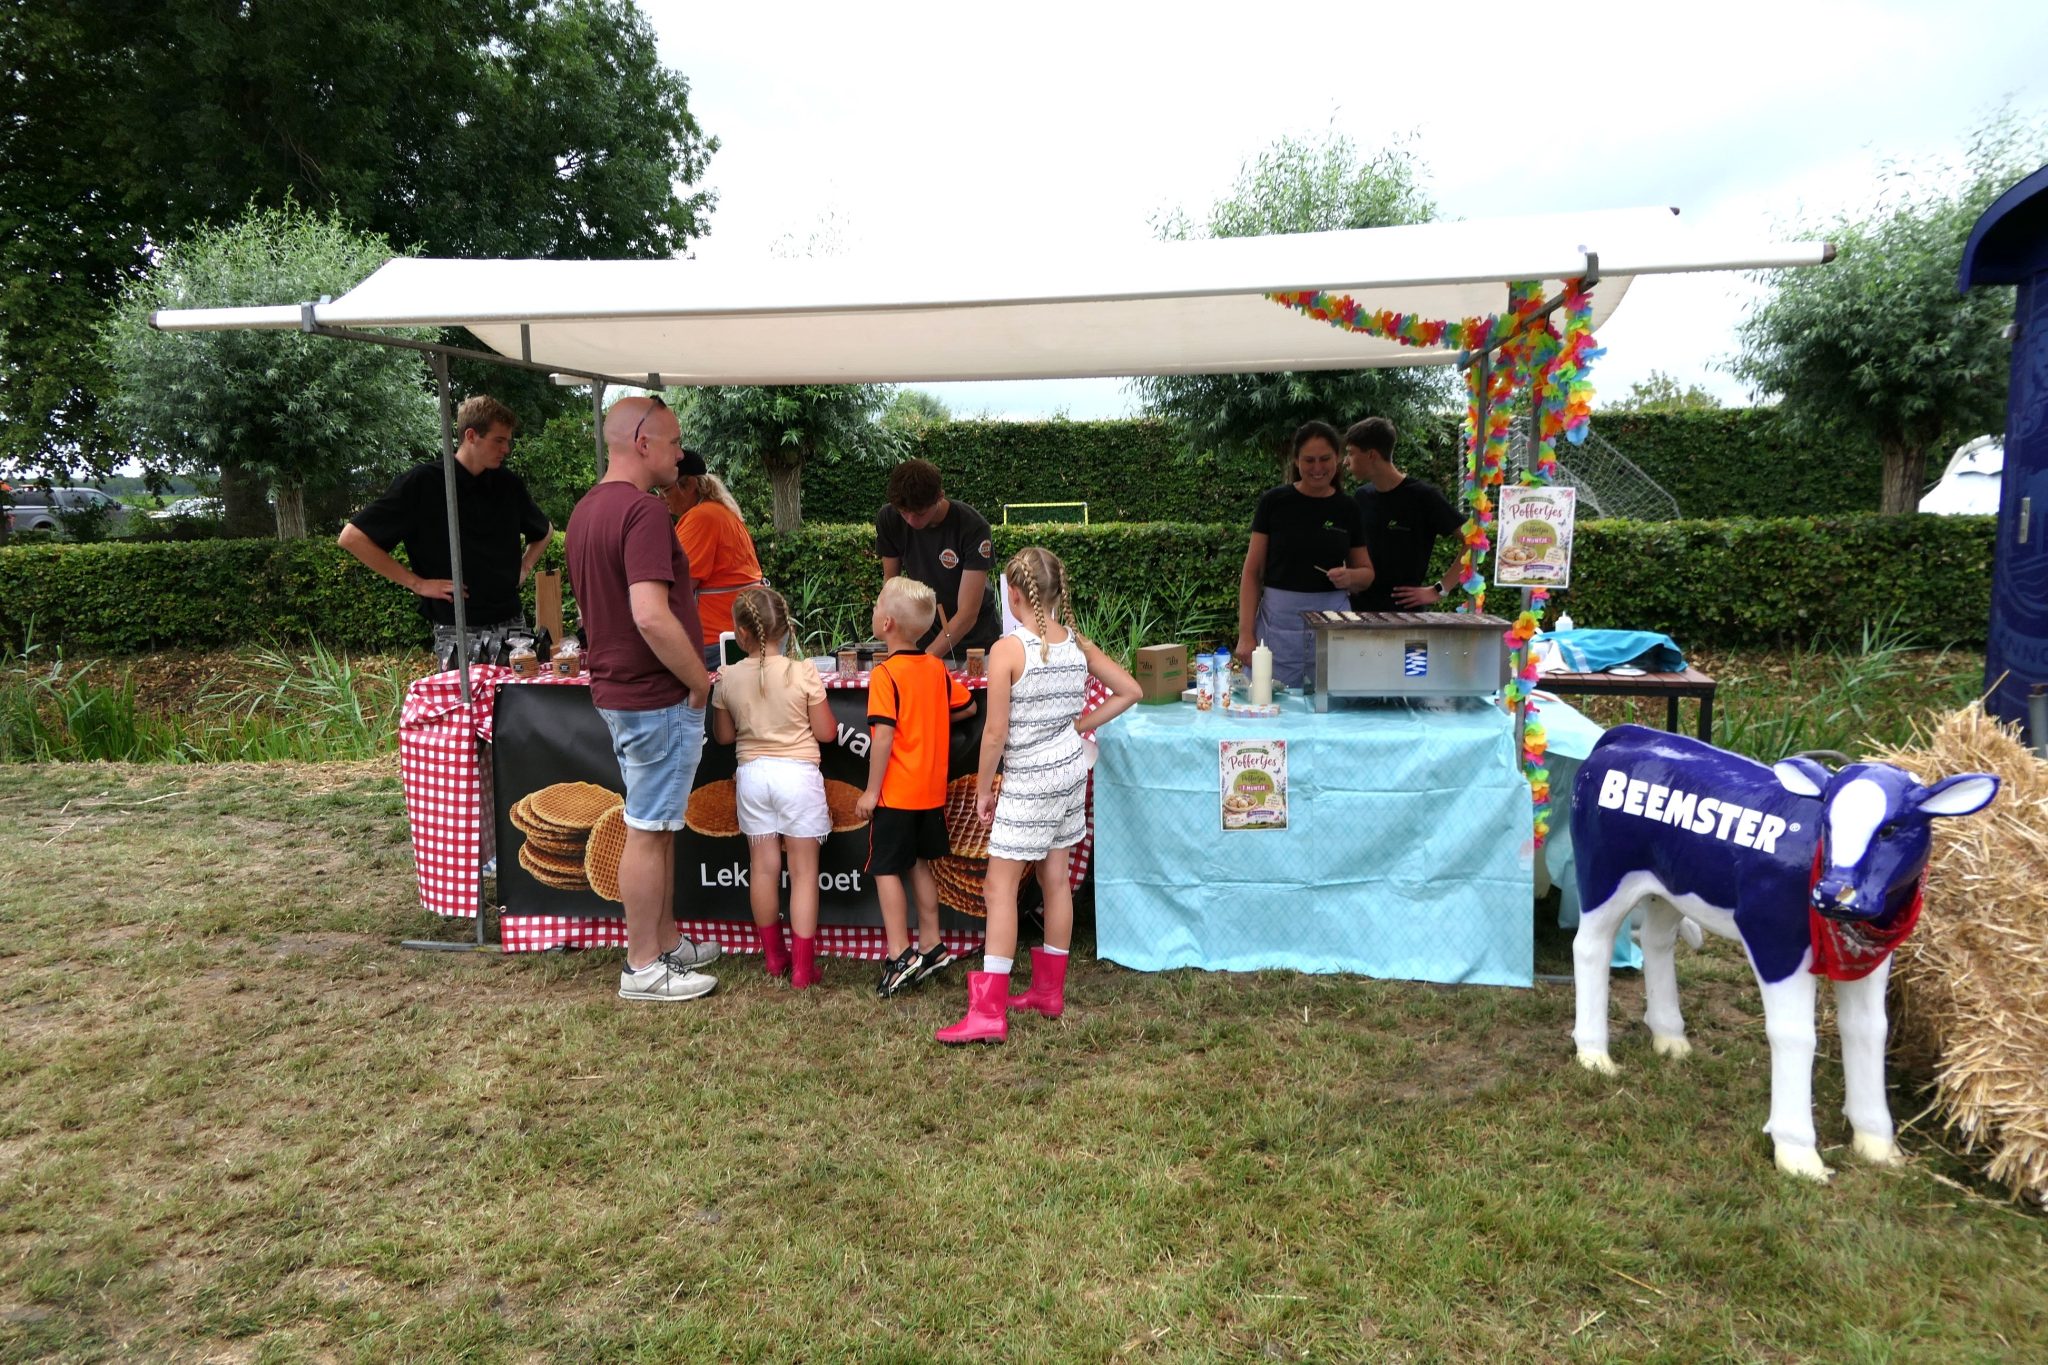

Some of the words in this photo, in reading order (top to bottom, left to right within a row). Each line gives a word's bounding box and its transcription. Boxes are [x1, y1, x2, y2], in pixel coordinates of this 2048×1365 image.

[1509, 503, 1562, 520] Poffertjes
[1228, 754, 1277, 770] Poffertjes
[1597, 769, 1787, 854] BEEMSTER
